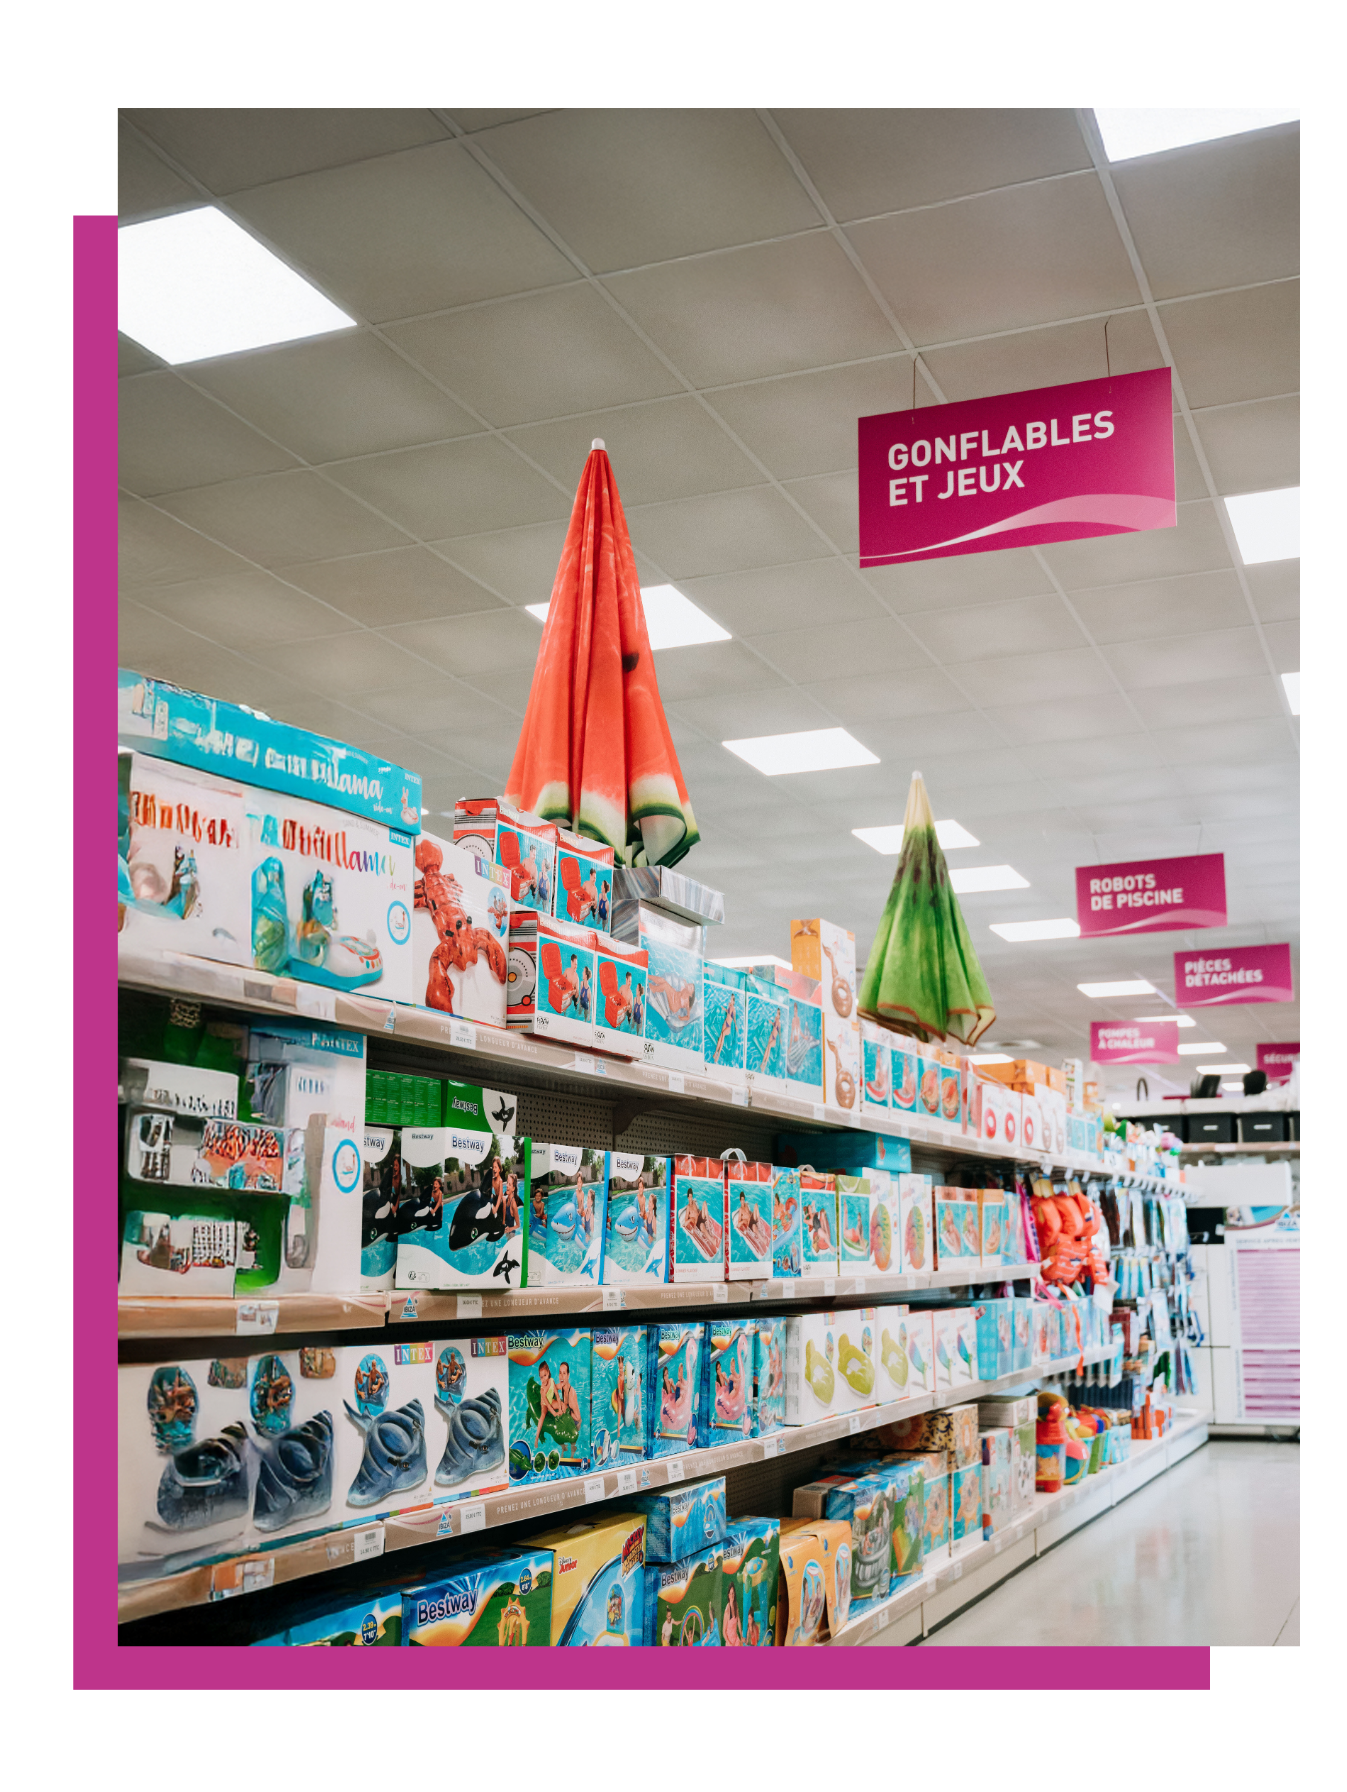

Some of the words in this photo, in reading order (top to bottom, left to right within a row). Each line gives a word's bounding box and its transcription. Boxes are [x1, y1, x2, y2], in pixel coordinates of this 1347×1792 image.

[888, 410, 1115, 471] GONFLABLES
[889, 475, 929, 507] ET
[937, 460, 1025, 500] JEUX
[404, 772, 421, 786] INTEX
[390, 832, 410, 846] INTEX
[476, 860, 510, 887] INTEX
[1089, 873, 1156, 894] ROBOTS
[1090, 894, 1113, 911] DE
[1116, 888, 1184, 909] PISCINE
[1184, 957, 1232, 974] PIÈCES
[1185, 968, 1264, 988] DÉTACHÉES
[1097, 1027, 1141, 1039] POMPES
[1108, 1037, 1156, 1050] CHALEUR
[451, 1095, 478, 1116] Bestway
[363, 1135, 386, 1152] stway
[411, 1133, 434, 1141] Bestway
[451, 1134, 485, 1152] Bestway
[554, 1150, 578, 1166] Bestway
[616, 1157, 640, 1173] Bestway
[508, 1334, 544, 1350] Bestway
[594, 1331, 620, 1346] Bestway
[395, 1347, 432, 1362] INTEX
[472, 1340, 506, 1355] INTEX
[496, 1502, 519, 1515] PRENEZ
[520, 1501, 532, 1510] UNE
[672, 1501, 690, 1514] Bestway
[438, 1521, 450, 1530] IBIZA
[723, 1544, 745, 1559] estway
[661, 1567, 689, 1587] Bestway
[417, 1588, 478, 1627] Bestway
